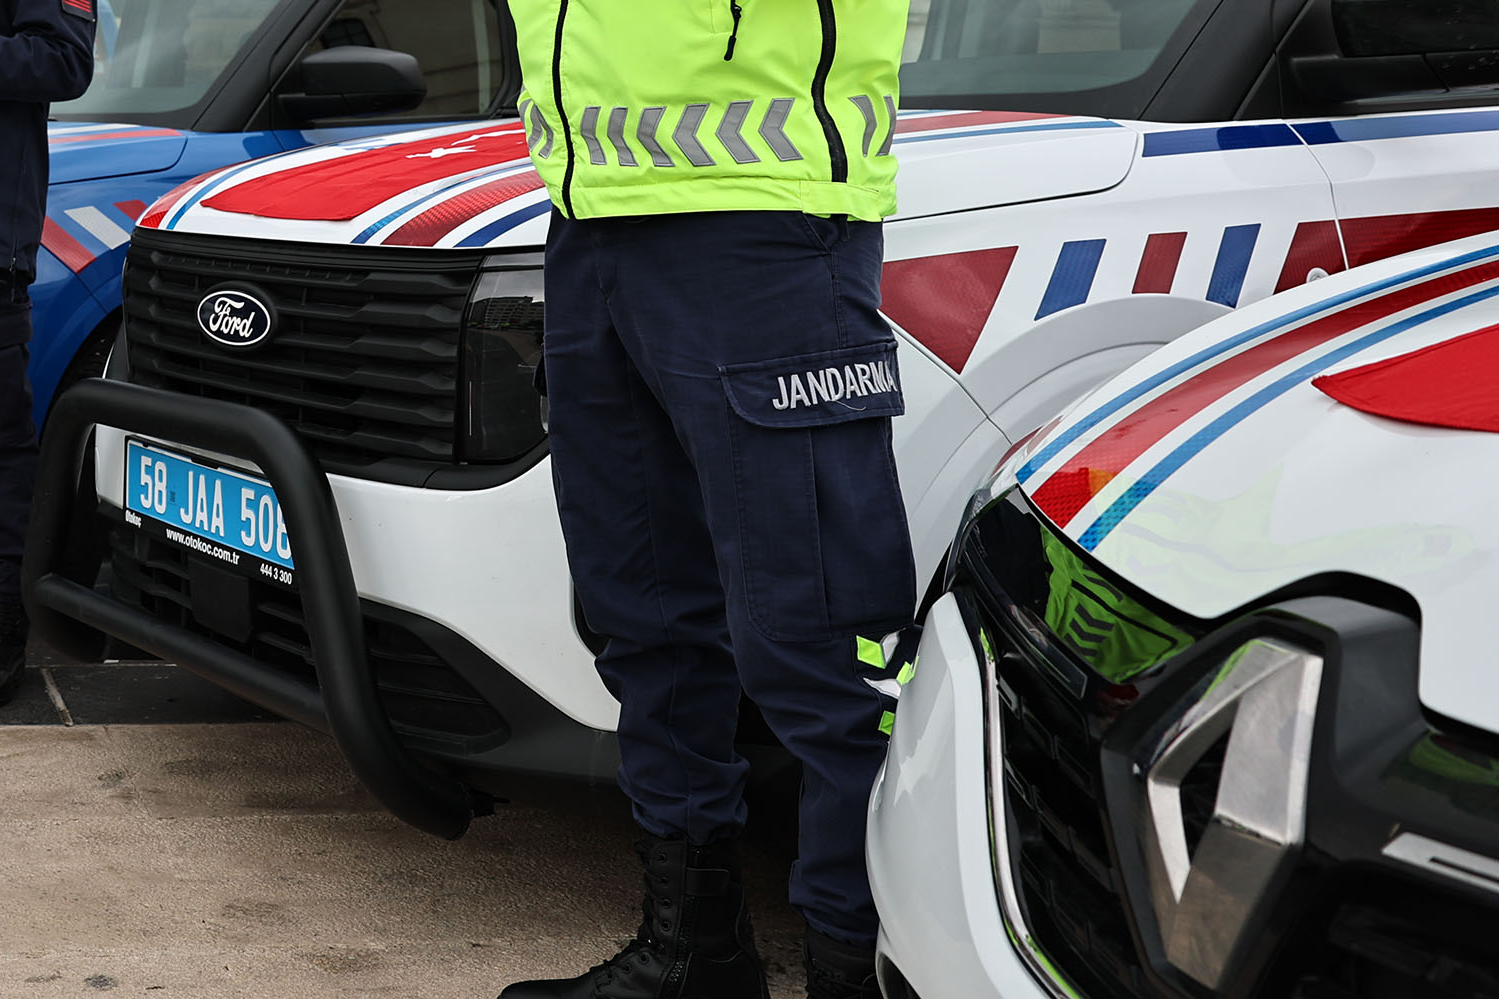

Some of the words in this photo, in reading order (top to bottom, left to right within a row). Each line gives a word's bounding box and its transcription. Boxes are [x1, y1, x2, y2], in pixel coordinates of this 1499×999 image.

[772, 361, 898, 410] JANDARMA
[140, 455, 167, 515] 58
[180, 471, 225, 538] JAA
[240, 487, 292, 560] 508
[166, 528, 240, 565] www.otokoc.com.tr
[260, 563, 273, 578] 444
[273, 569, 279, 580] 3
[279, 570, 293, 585] 300
